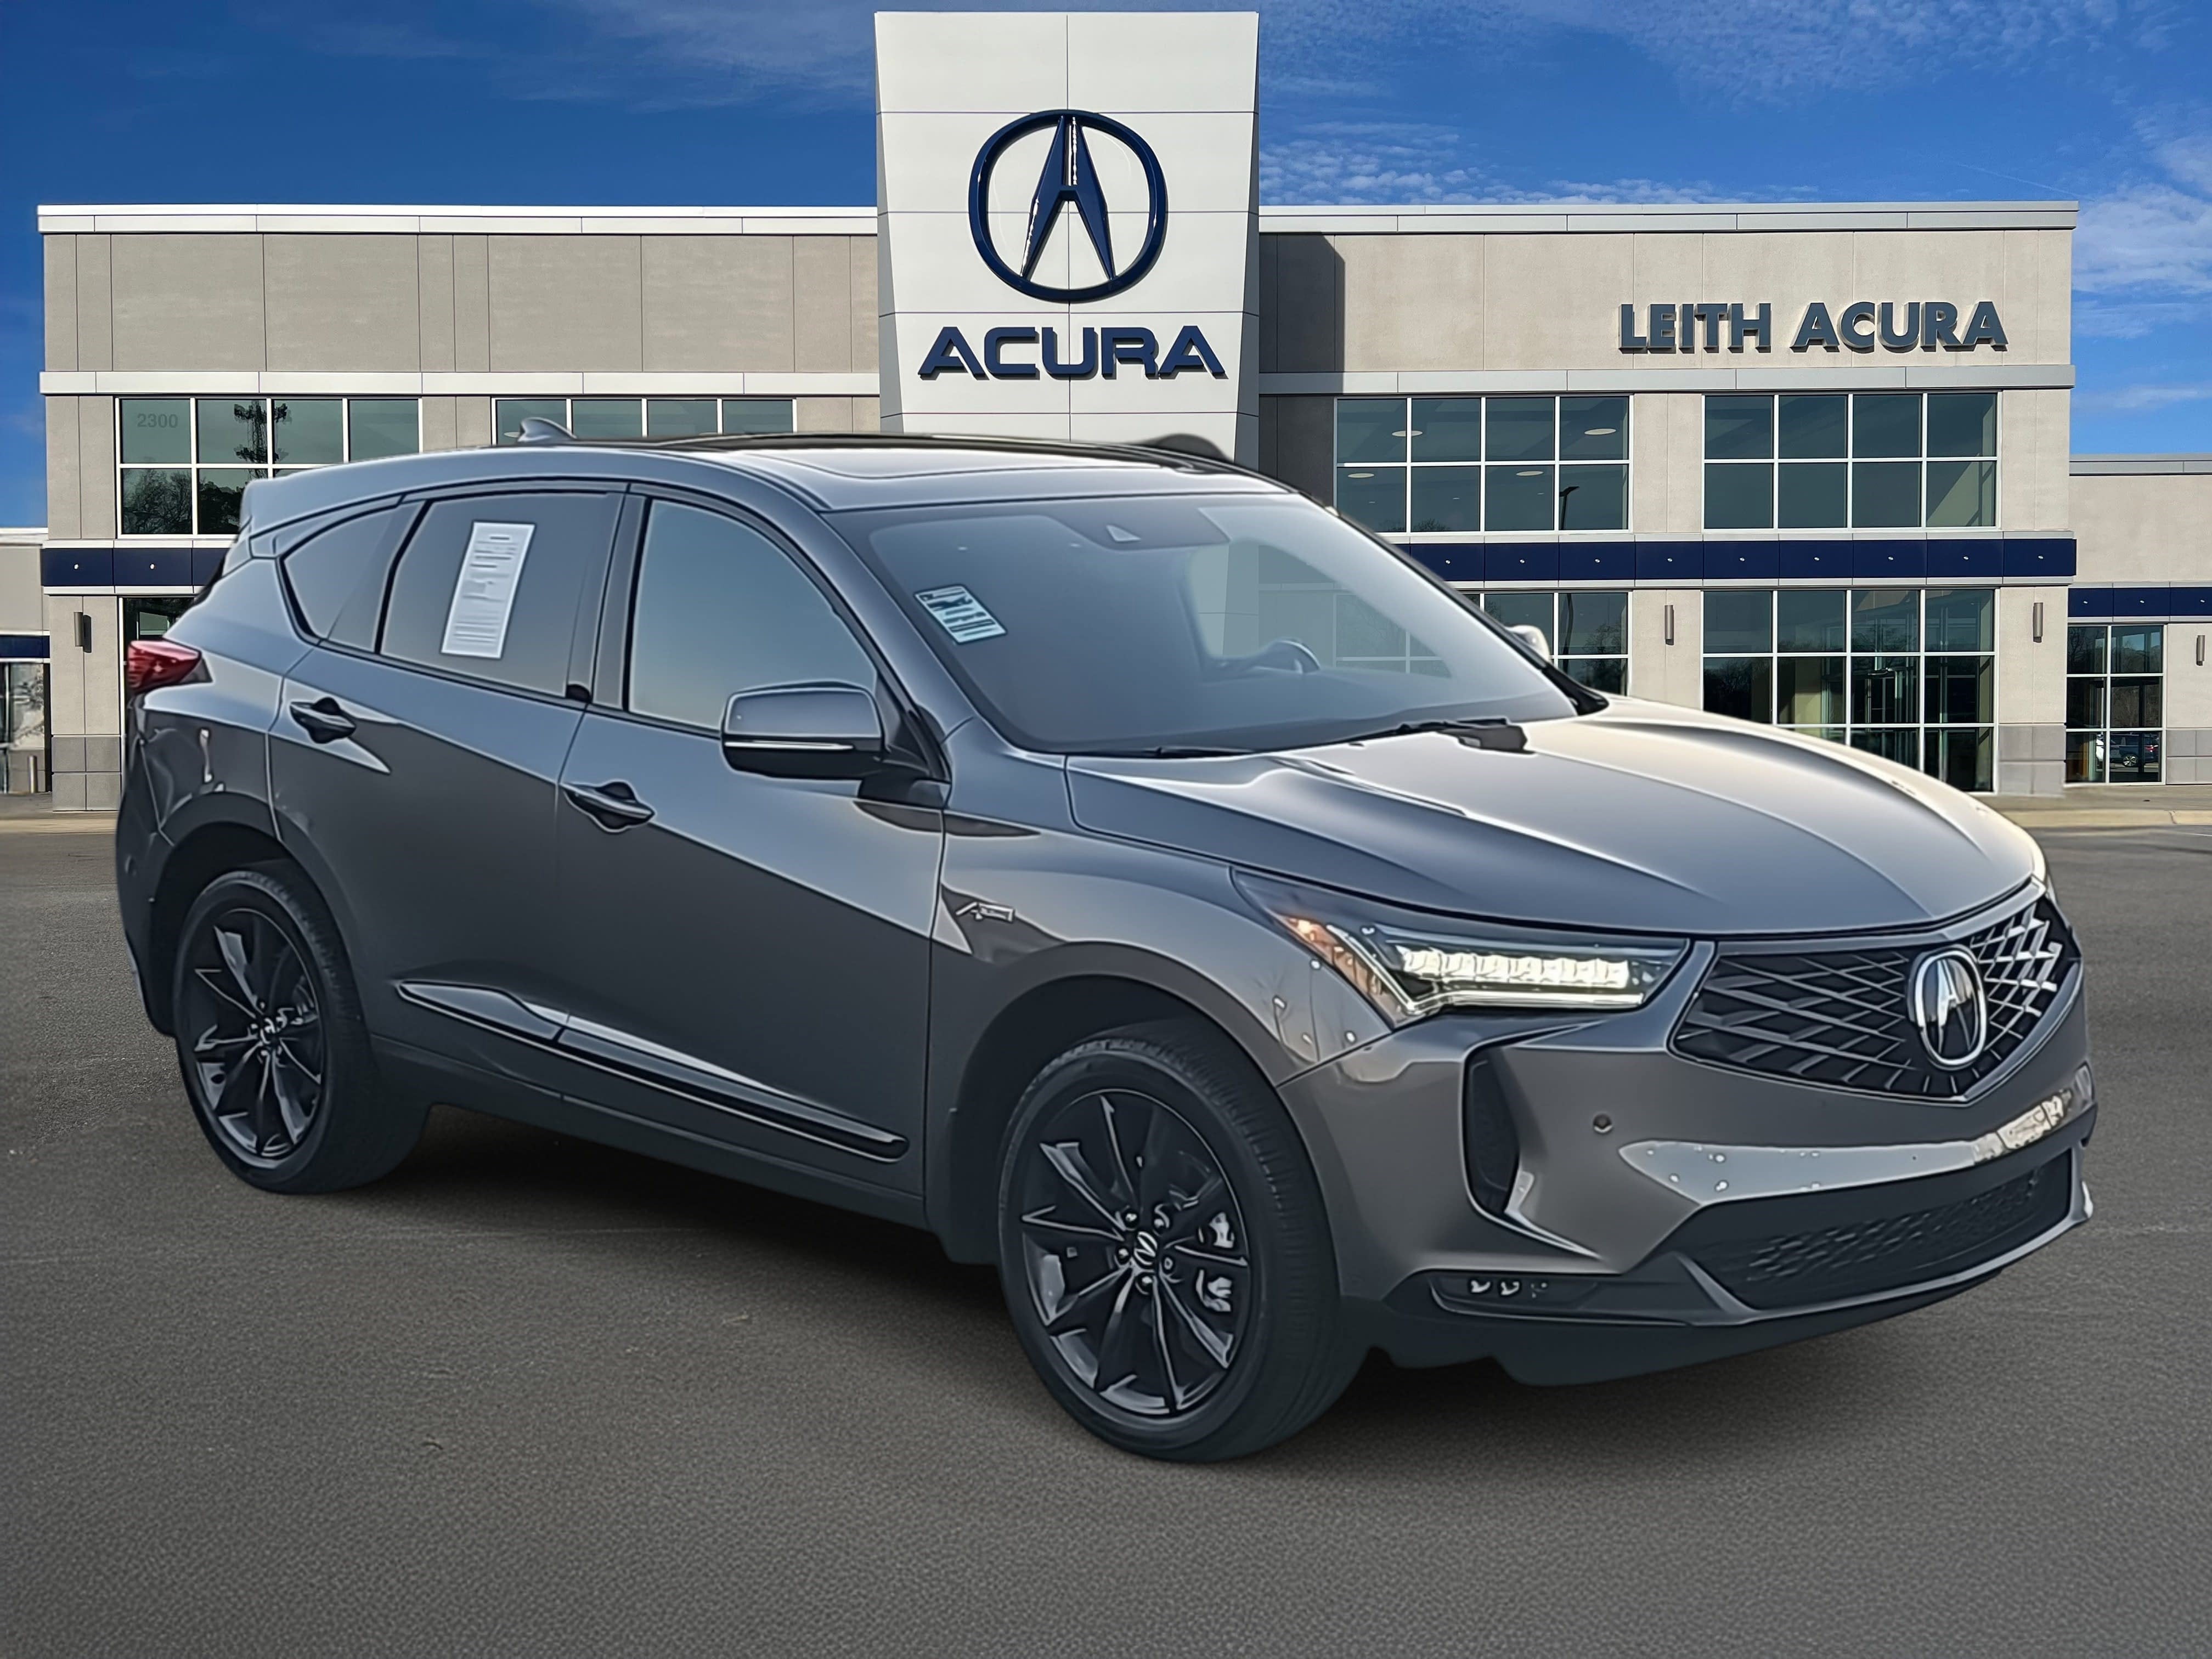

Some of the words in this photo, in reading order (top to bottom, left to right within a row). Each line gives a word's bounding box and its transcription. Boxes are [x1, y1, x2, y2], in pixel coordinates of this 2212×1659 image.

[918, 325, 1228, 380] ACURA
[1619, 303, 1771, 353] LEITH
[1790, 301, 2008, 353] ACURA
[137, 414, 178, 428] 2300
